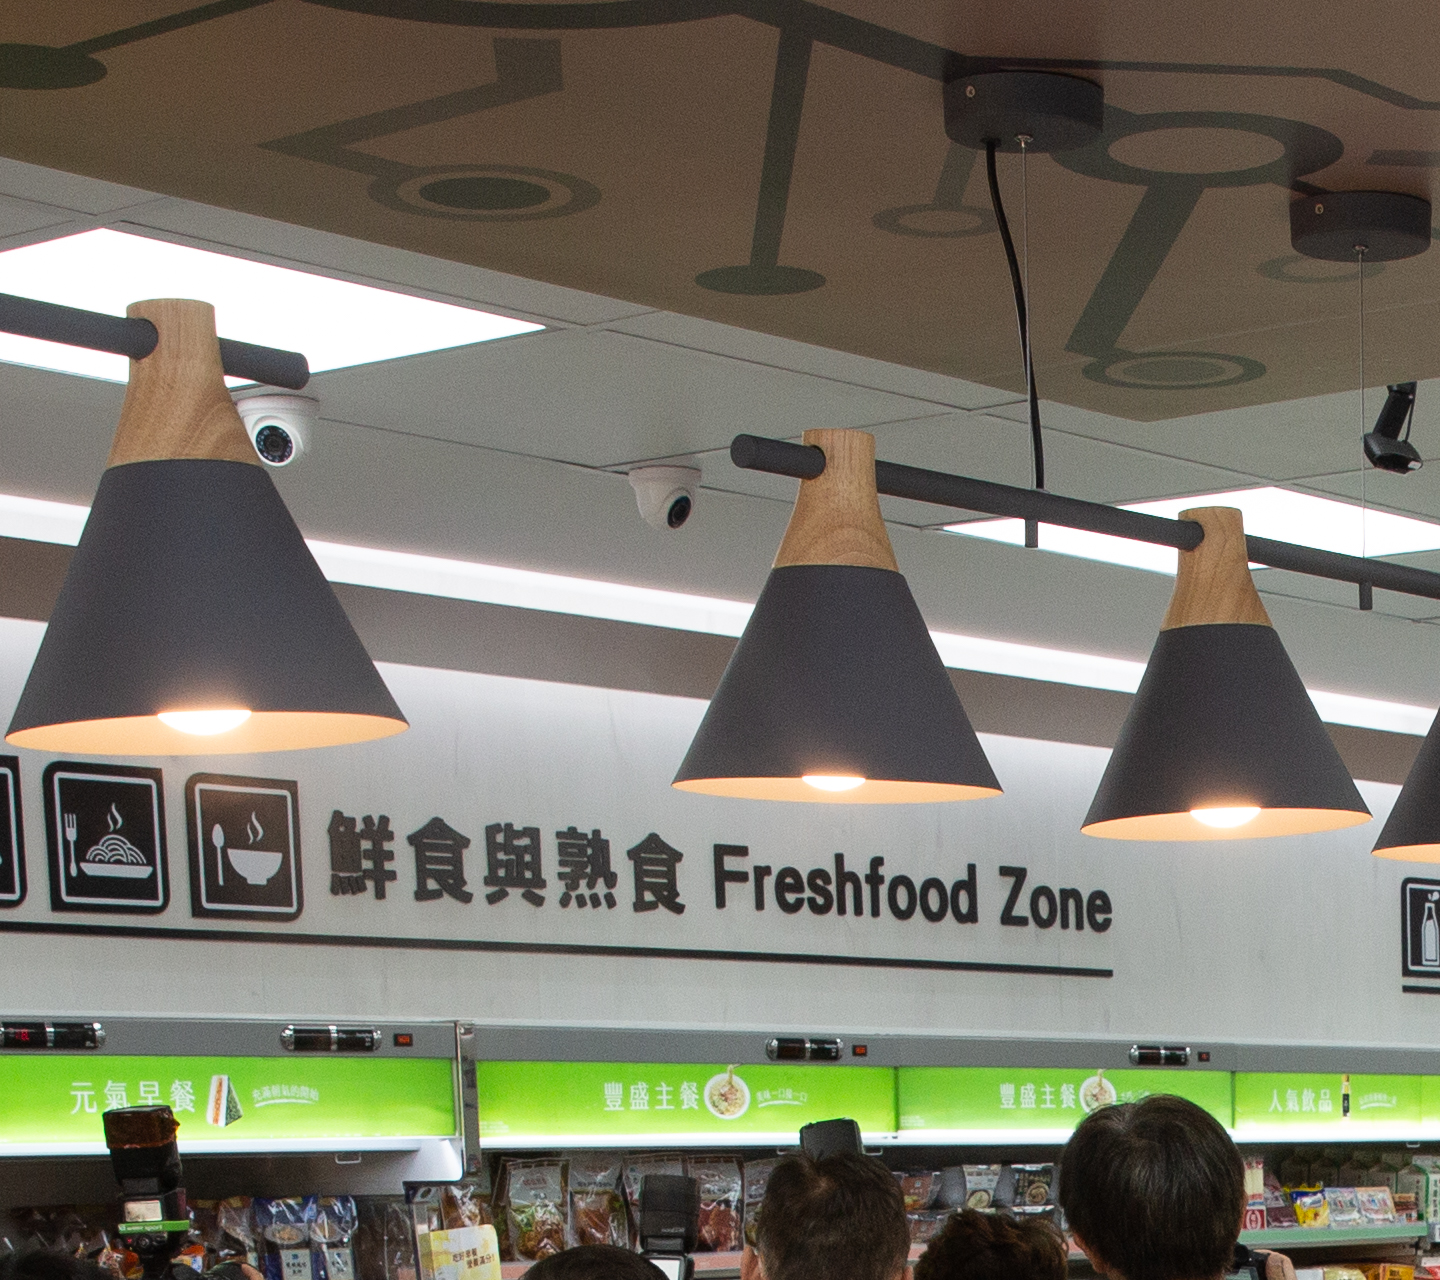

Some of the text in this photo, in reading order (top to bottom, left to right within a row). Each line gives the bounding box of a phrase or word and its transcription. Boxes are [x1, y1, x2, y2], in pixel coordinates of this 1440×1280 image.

[713, 843, 978, 924] Freshfood
[999, 865, 1113, 933] Zone
[70, 1080, 196, 1115] 元氣早餐
[603, 1081, 700, 1112] 豐盛主餐
[1000, 1083, 1077, 1110] 豐盛主餐
[1268, 1088, 1333, 1114] 人氣飲品
